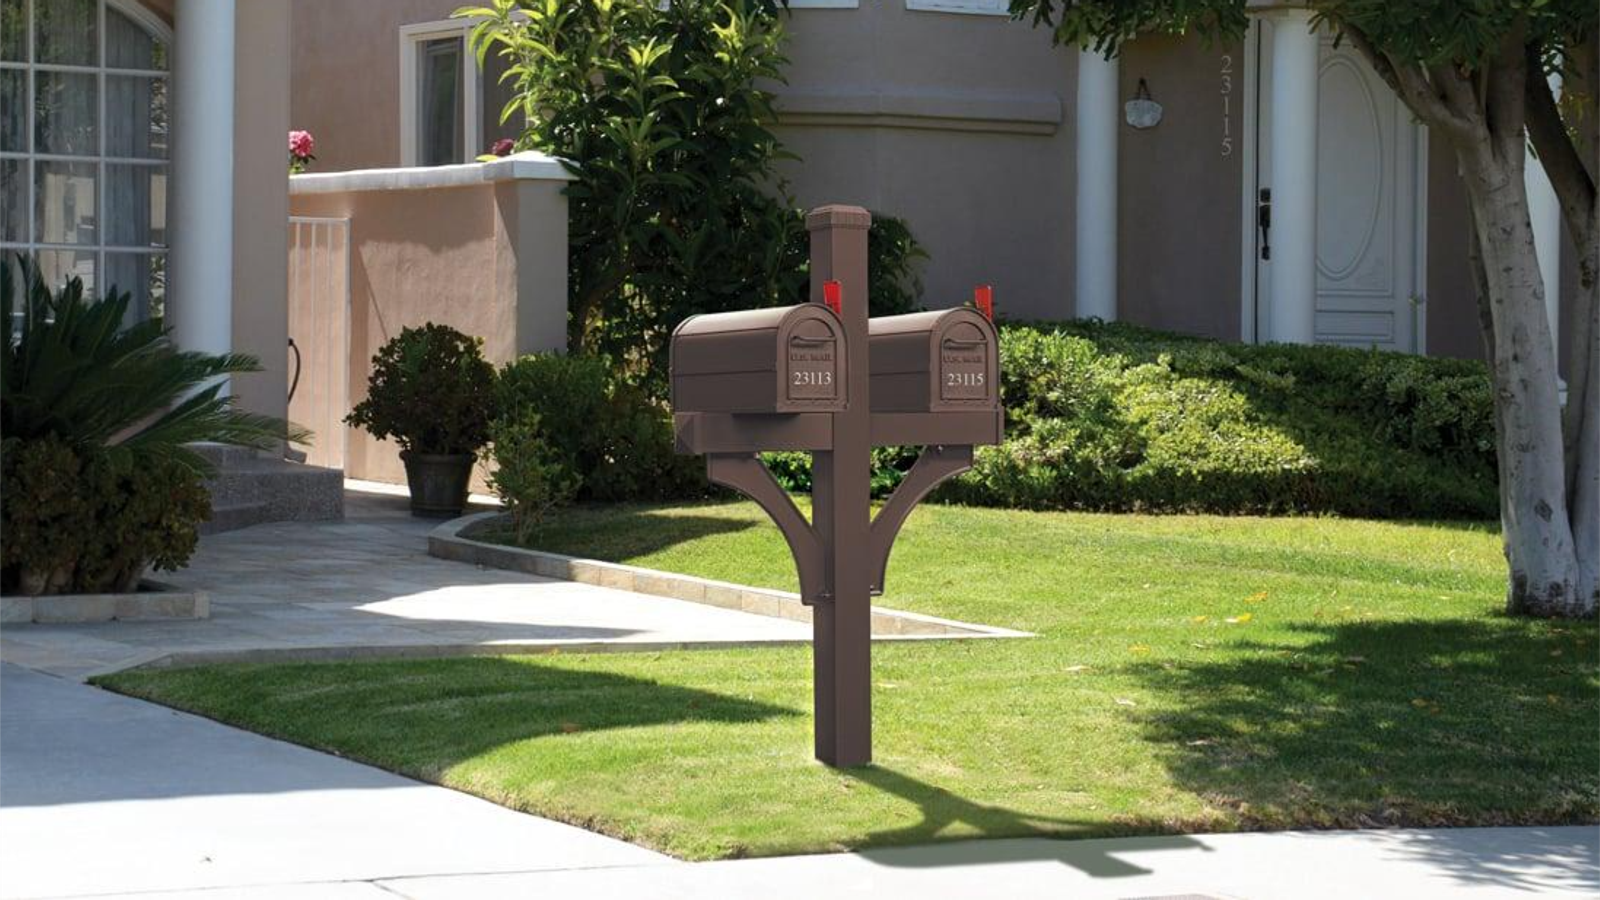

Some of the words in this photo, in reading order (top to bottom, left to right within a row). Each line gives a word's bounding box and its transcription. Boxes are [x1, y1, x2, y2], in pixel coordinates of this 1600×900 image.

[1220, 55, 1233, 156] 23115
[793, 371, 832, 385] 23113
[947, 373, 984, 386] 23115
